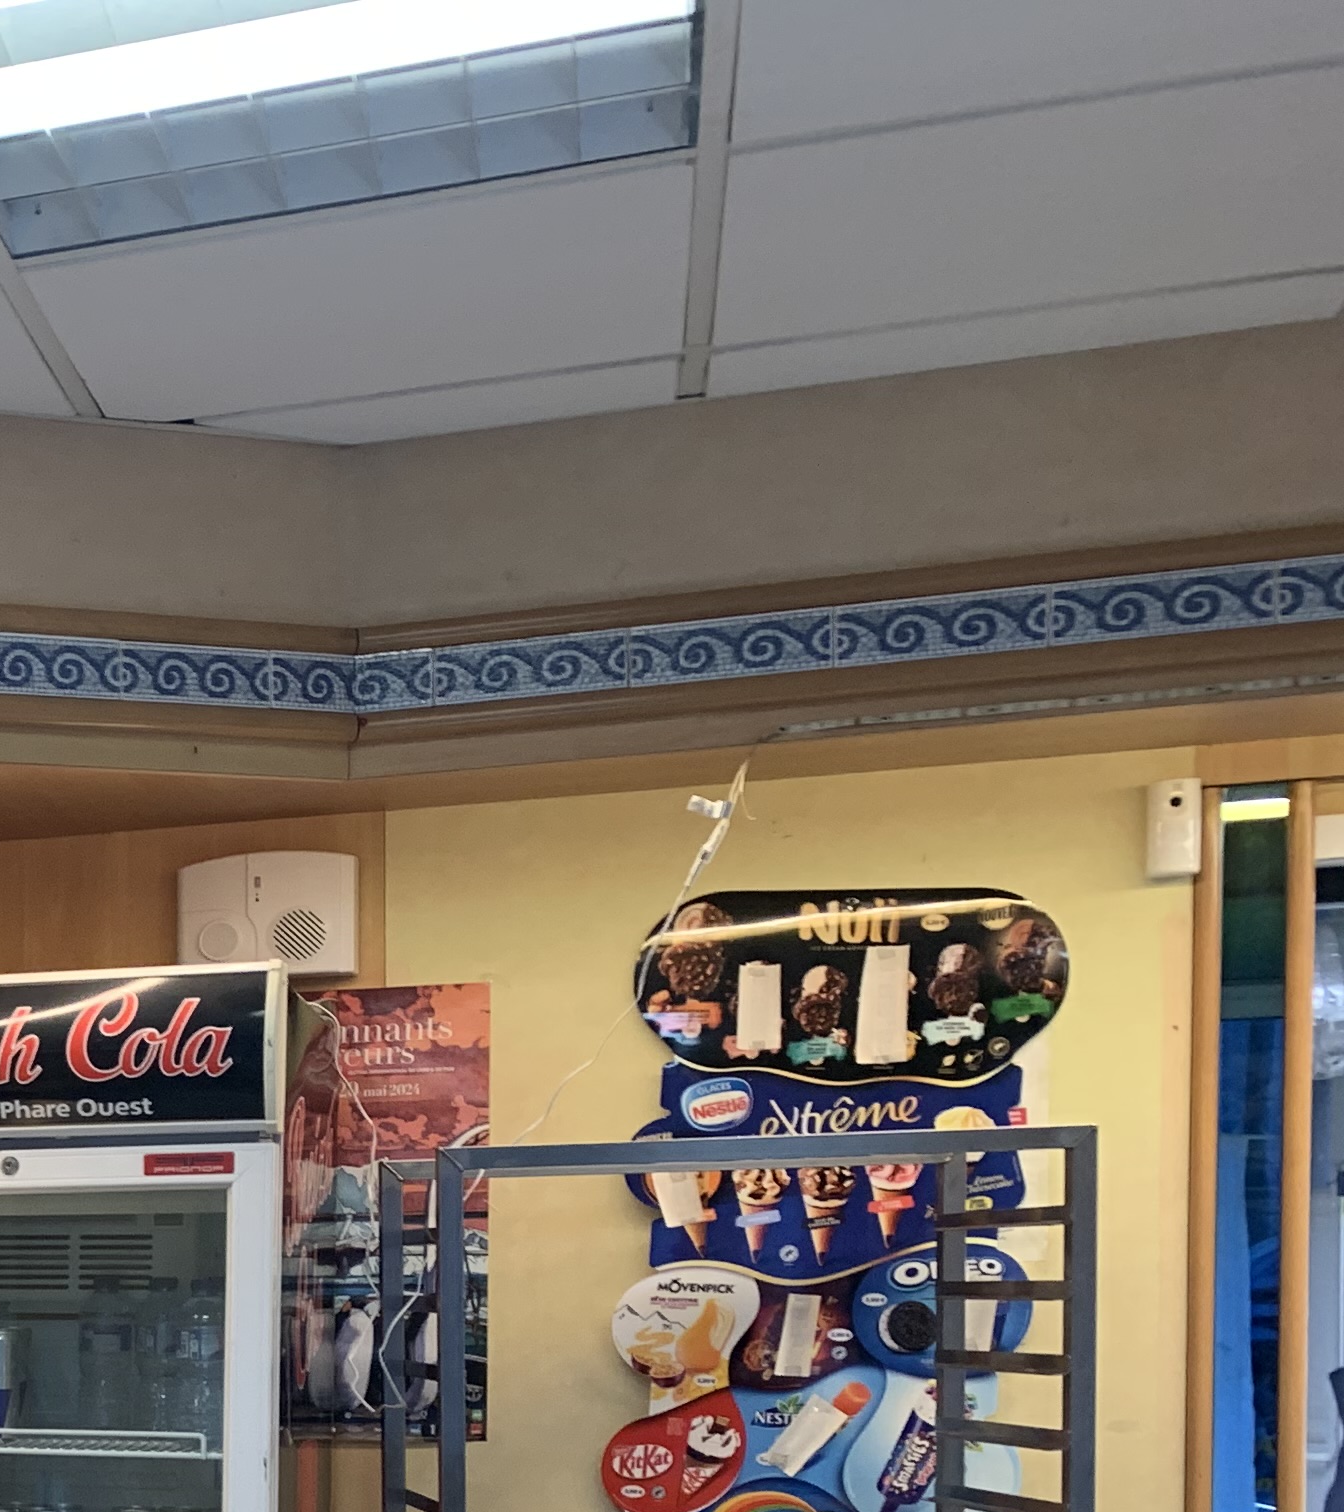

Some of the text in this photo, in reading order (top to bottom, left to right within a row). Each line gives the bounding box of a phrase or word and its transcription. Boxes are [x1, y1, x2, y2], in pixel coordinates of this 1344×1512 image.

[66, 990, 234, 1083] Cola
[340, 1017, 454, 1044] nnants
[363, 1084, 387, 1097] mai
[388, 1082, 421, 1097] 2024
[0, 1100, 70, 1121] Phare
[76, 1097, 154, 1118] Ouest
[754, 1410, 796, 1425] NEST
[618, 1445, 670, 1478] KitKat
